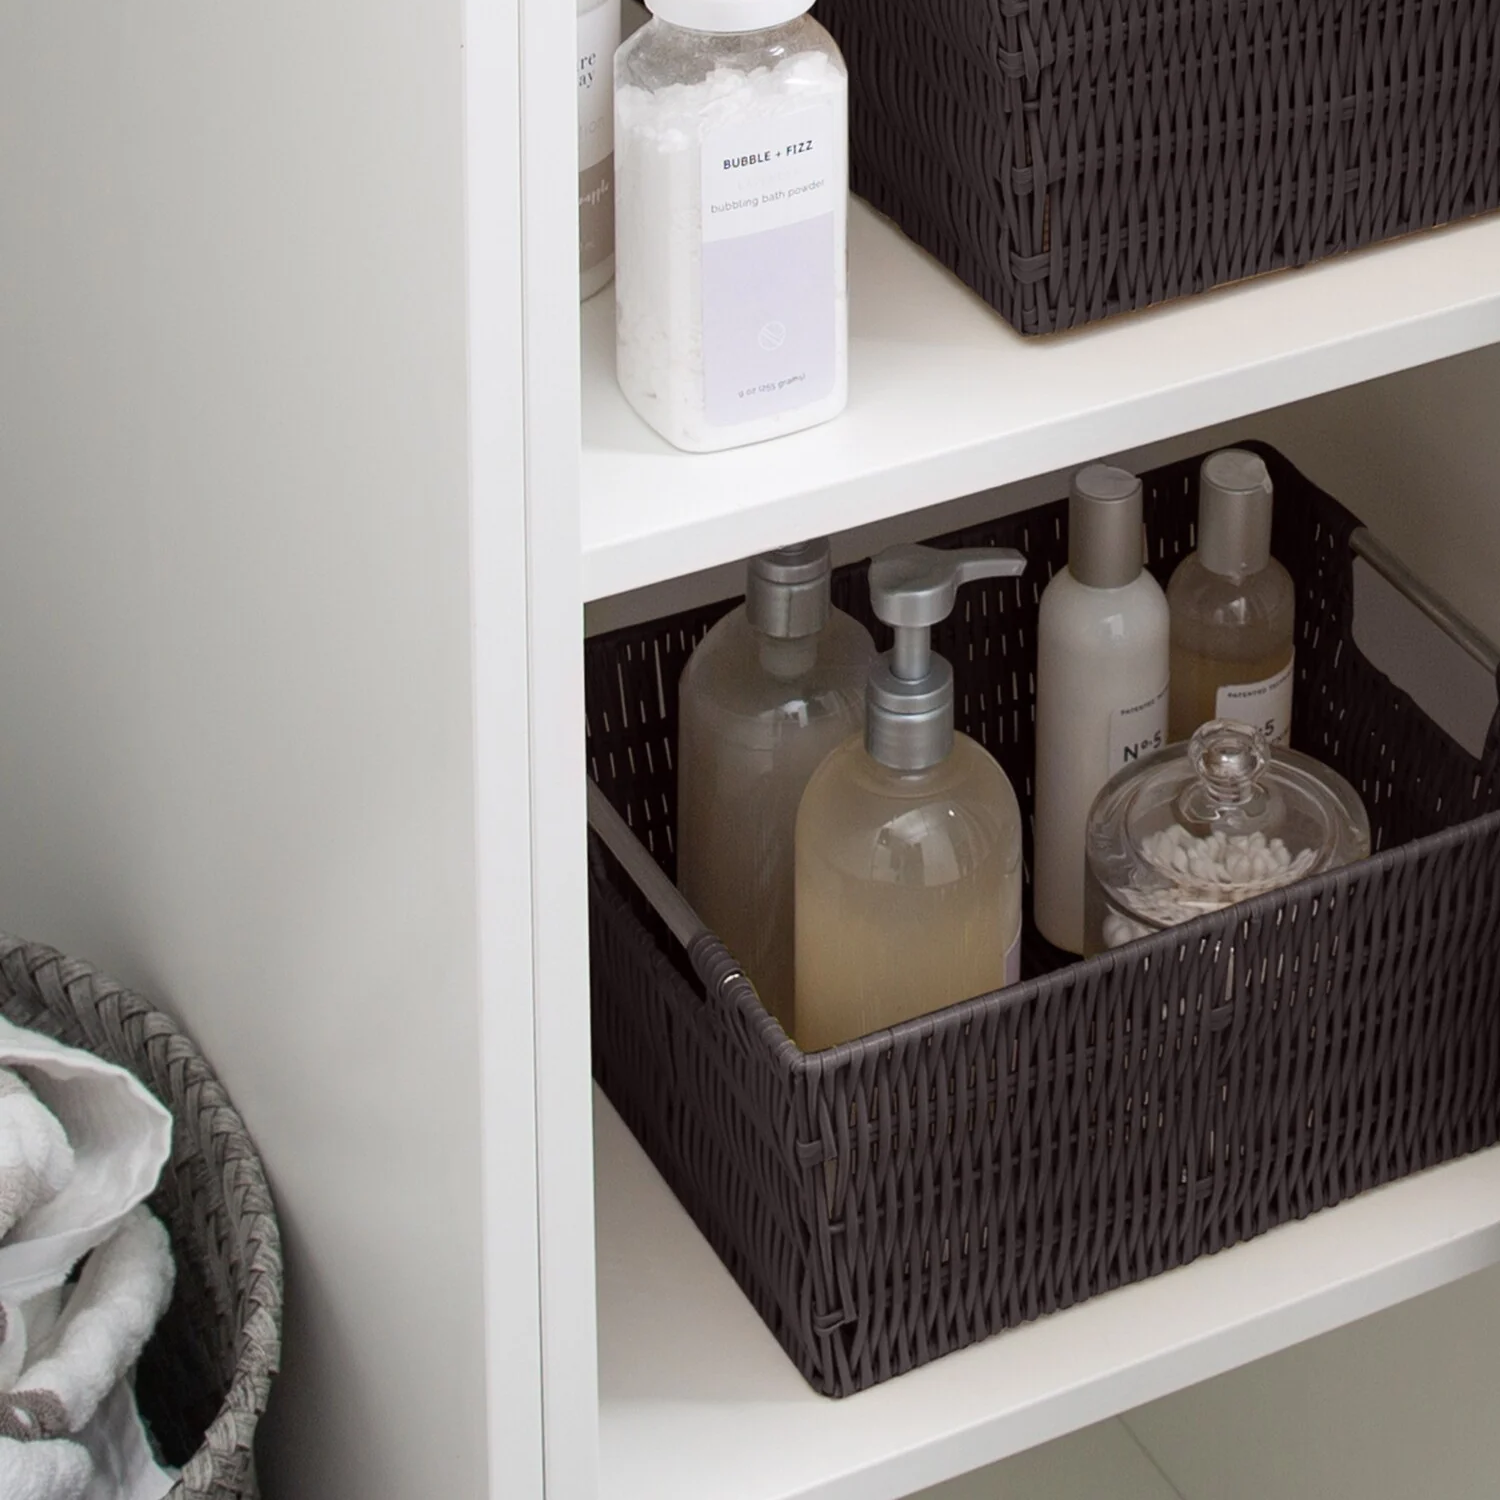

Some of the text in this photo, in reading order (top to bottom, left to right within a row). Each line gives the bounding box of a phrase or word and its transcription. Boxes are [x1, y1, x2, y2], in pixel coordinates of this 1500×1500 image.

[723, 151, 771, 170] BUBBLE
[786, 140, 813, 156] FIZZ
[711, 197, 759, 214] bubbling
[761, 191, 785, 203] bath
[787, 179, 825, 198] powder
